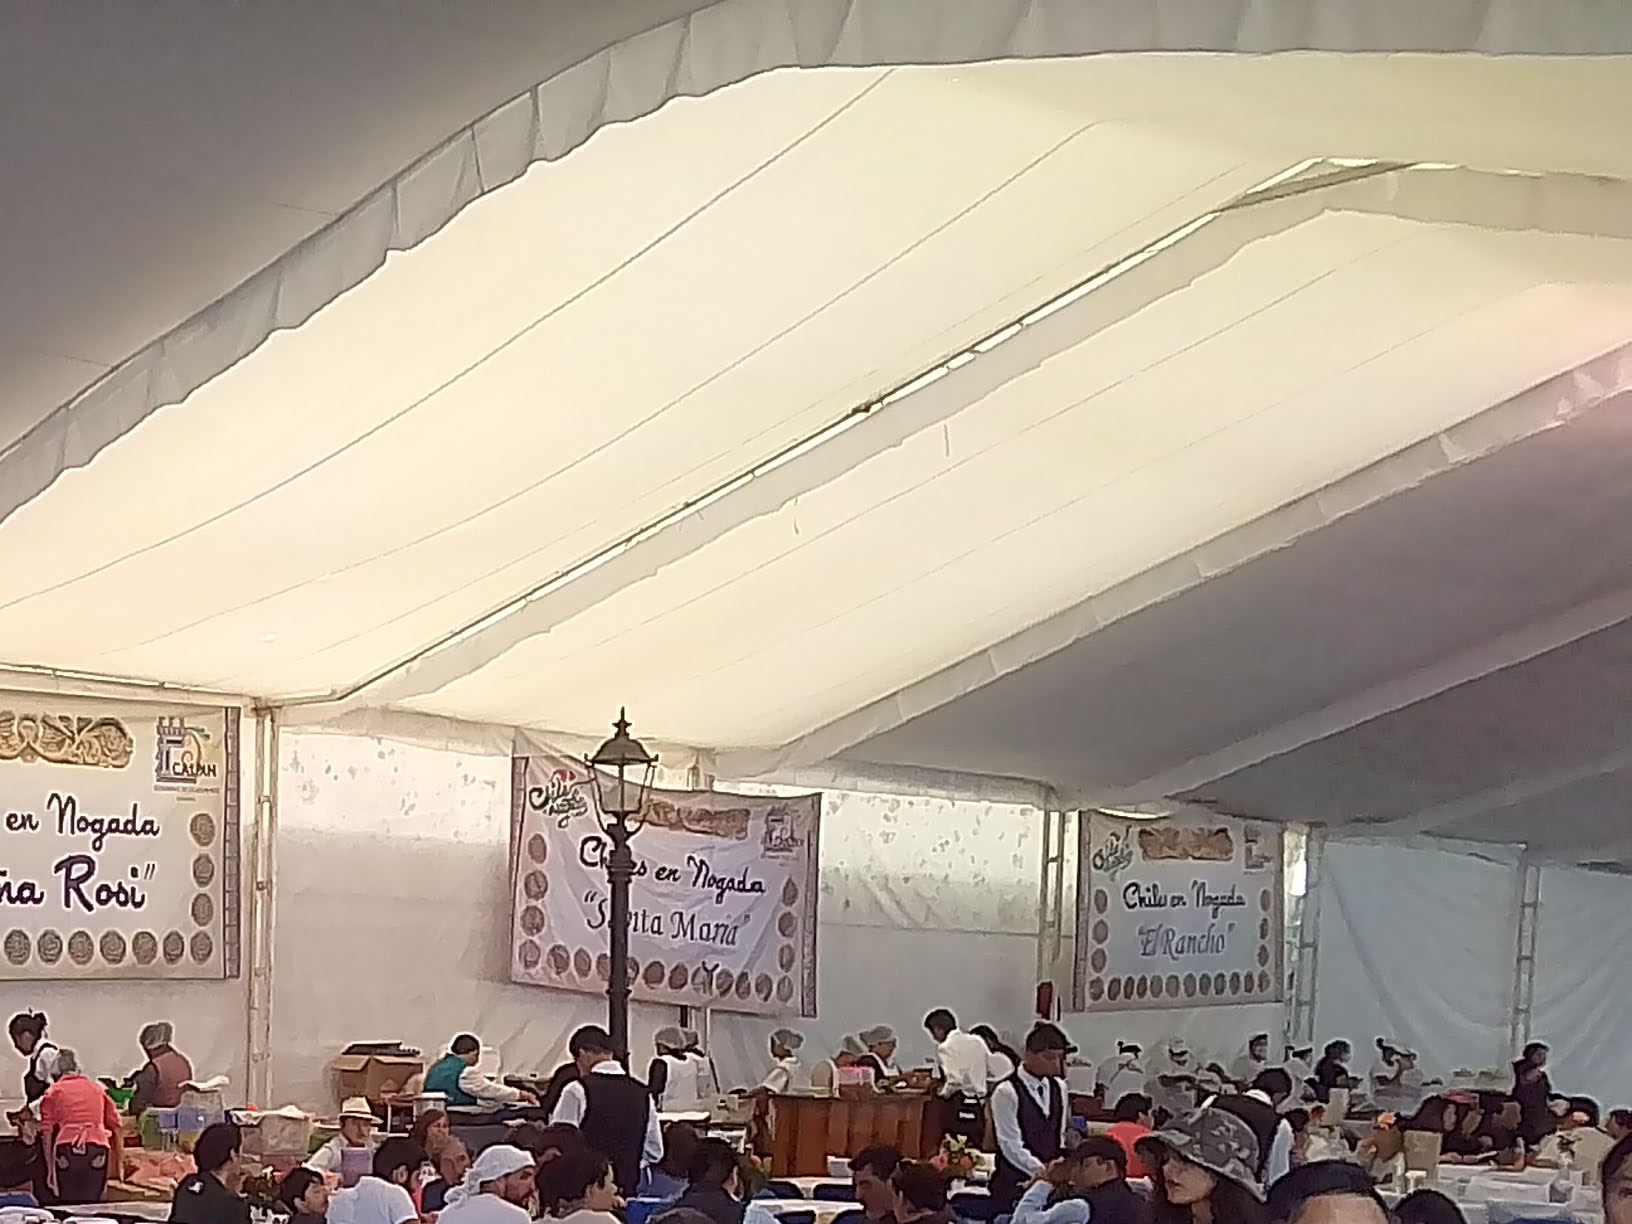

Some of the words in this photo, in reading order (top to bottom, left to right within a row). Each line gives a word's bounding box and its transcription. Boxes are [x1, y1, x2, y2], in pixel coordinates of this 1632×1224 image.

[5, 807, 39, 834] en
[47, 793, 161, 853] Nogada
[654, 865, 682, 883] en
[686, 854, 767, 904] Nogada
